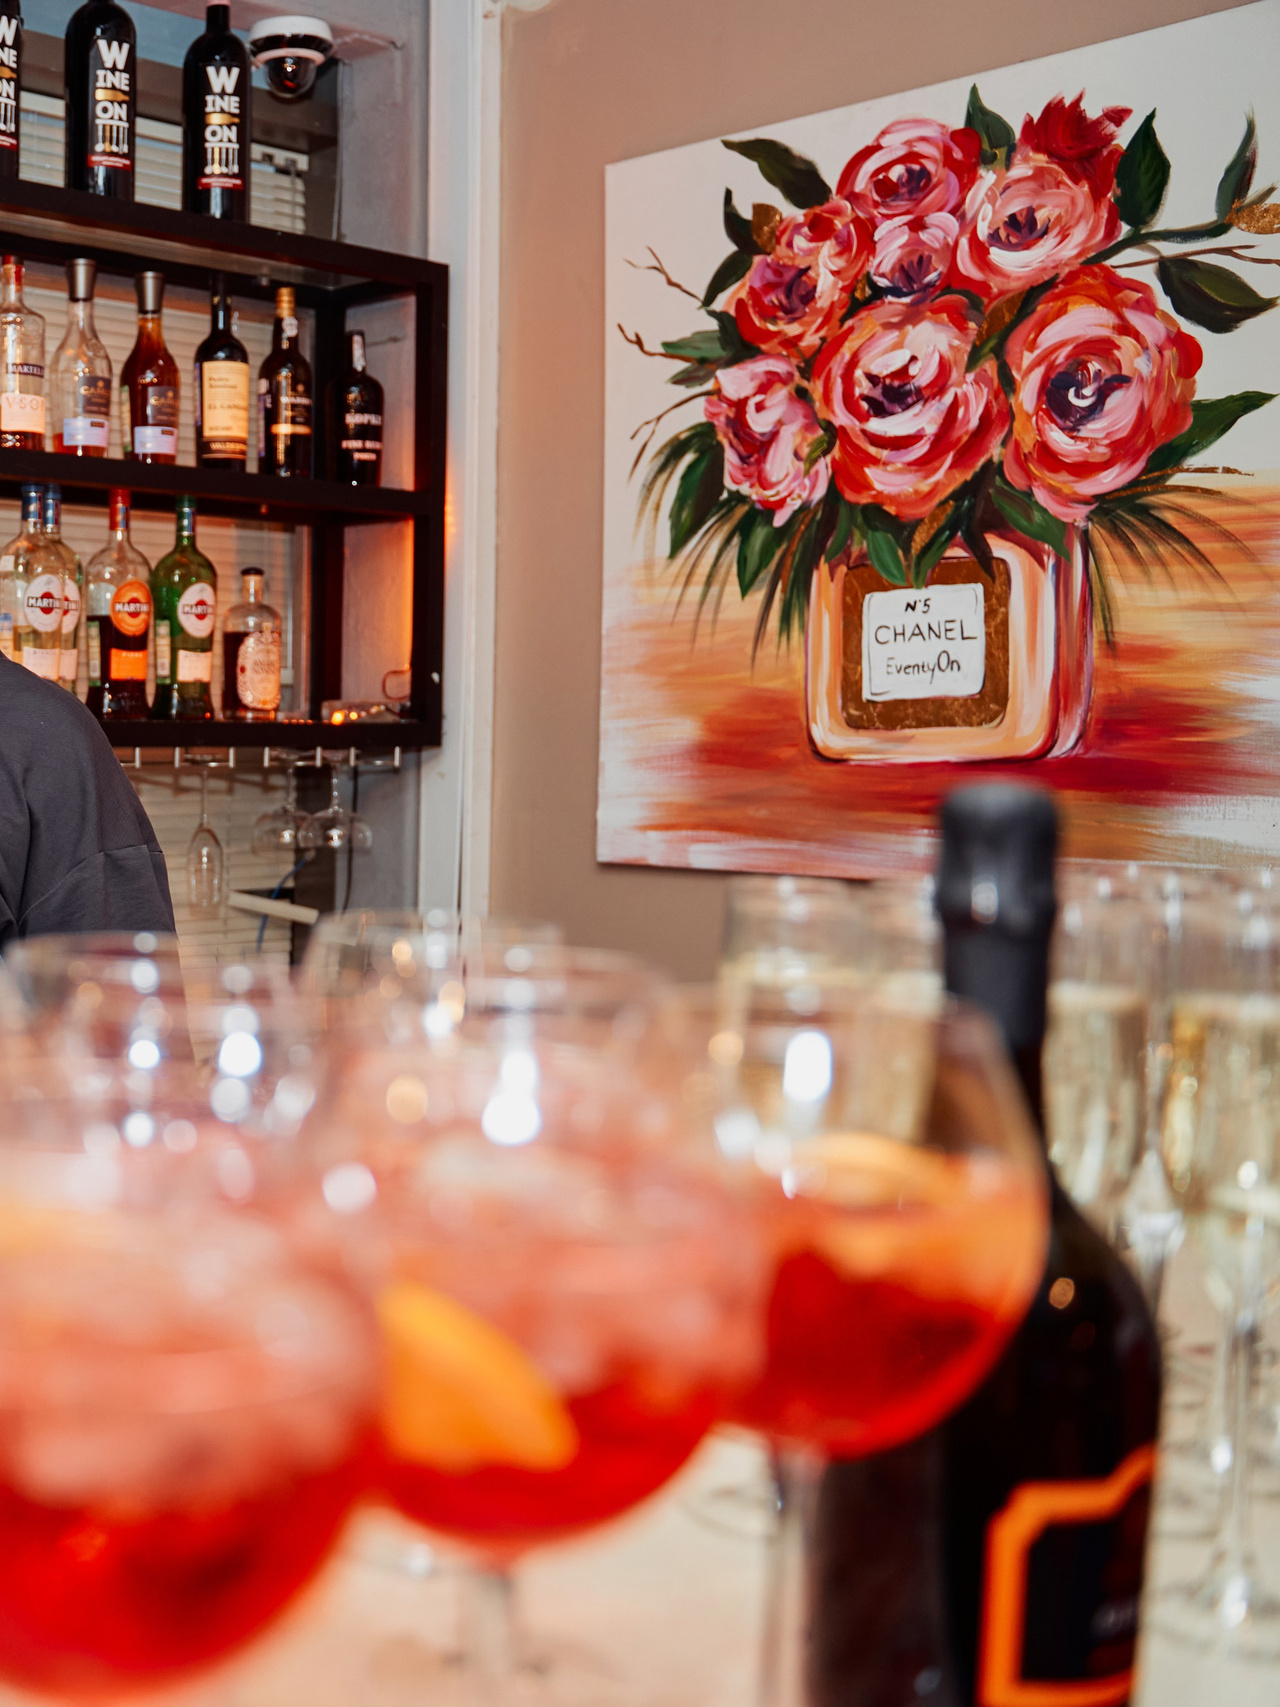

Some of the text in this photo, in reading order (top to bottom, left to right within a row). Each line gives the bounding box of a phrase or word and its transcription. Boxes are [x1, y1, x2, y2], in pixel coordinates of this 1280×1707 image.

[97, 39, 130, 70] W
[95, 69, 130, 91] INE
[205, 65, 240, 94] W
[95, 100, 128, 121] ON
[204, 94, 240, 114] INE
[204, 124, 237, 143] ON
[28, 596, 61, 609] MARTIN
[874, 618, 978, 645] CHANEL
[885, 649, 961, 685] EventyOn
